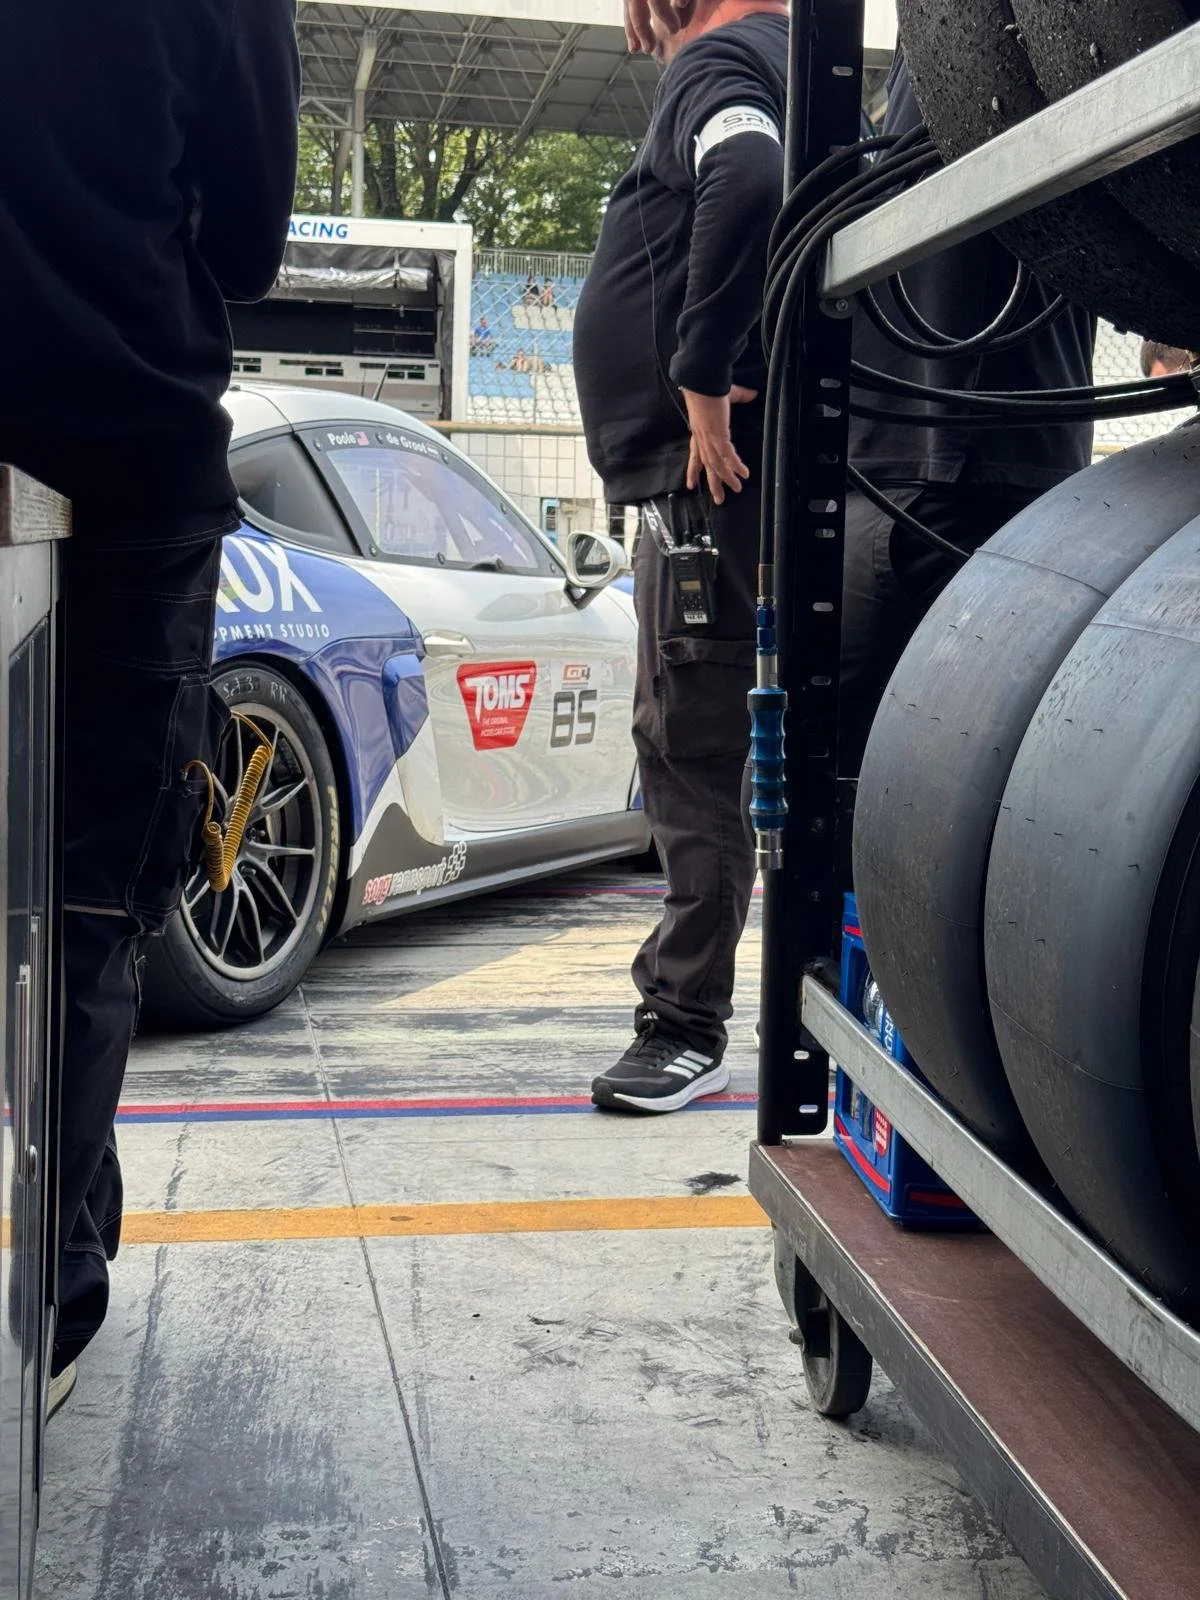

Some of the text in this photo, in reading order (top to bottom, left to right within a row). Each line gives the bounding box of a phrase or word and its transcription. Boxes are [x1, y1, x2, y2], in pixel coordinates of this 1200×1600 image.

[327, 432, 356, 445] Poole
[386, 432, 400, 446] de
[280, 624, 330, 638] STUDIO
[465, 674, 530, 724] TOMS
[551, 689, 598, 748] 85
